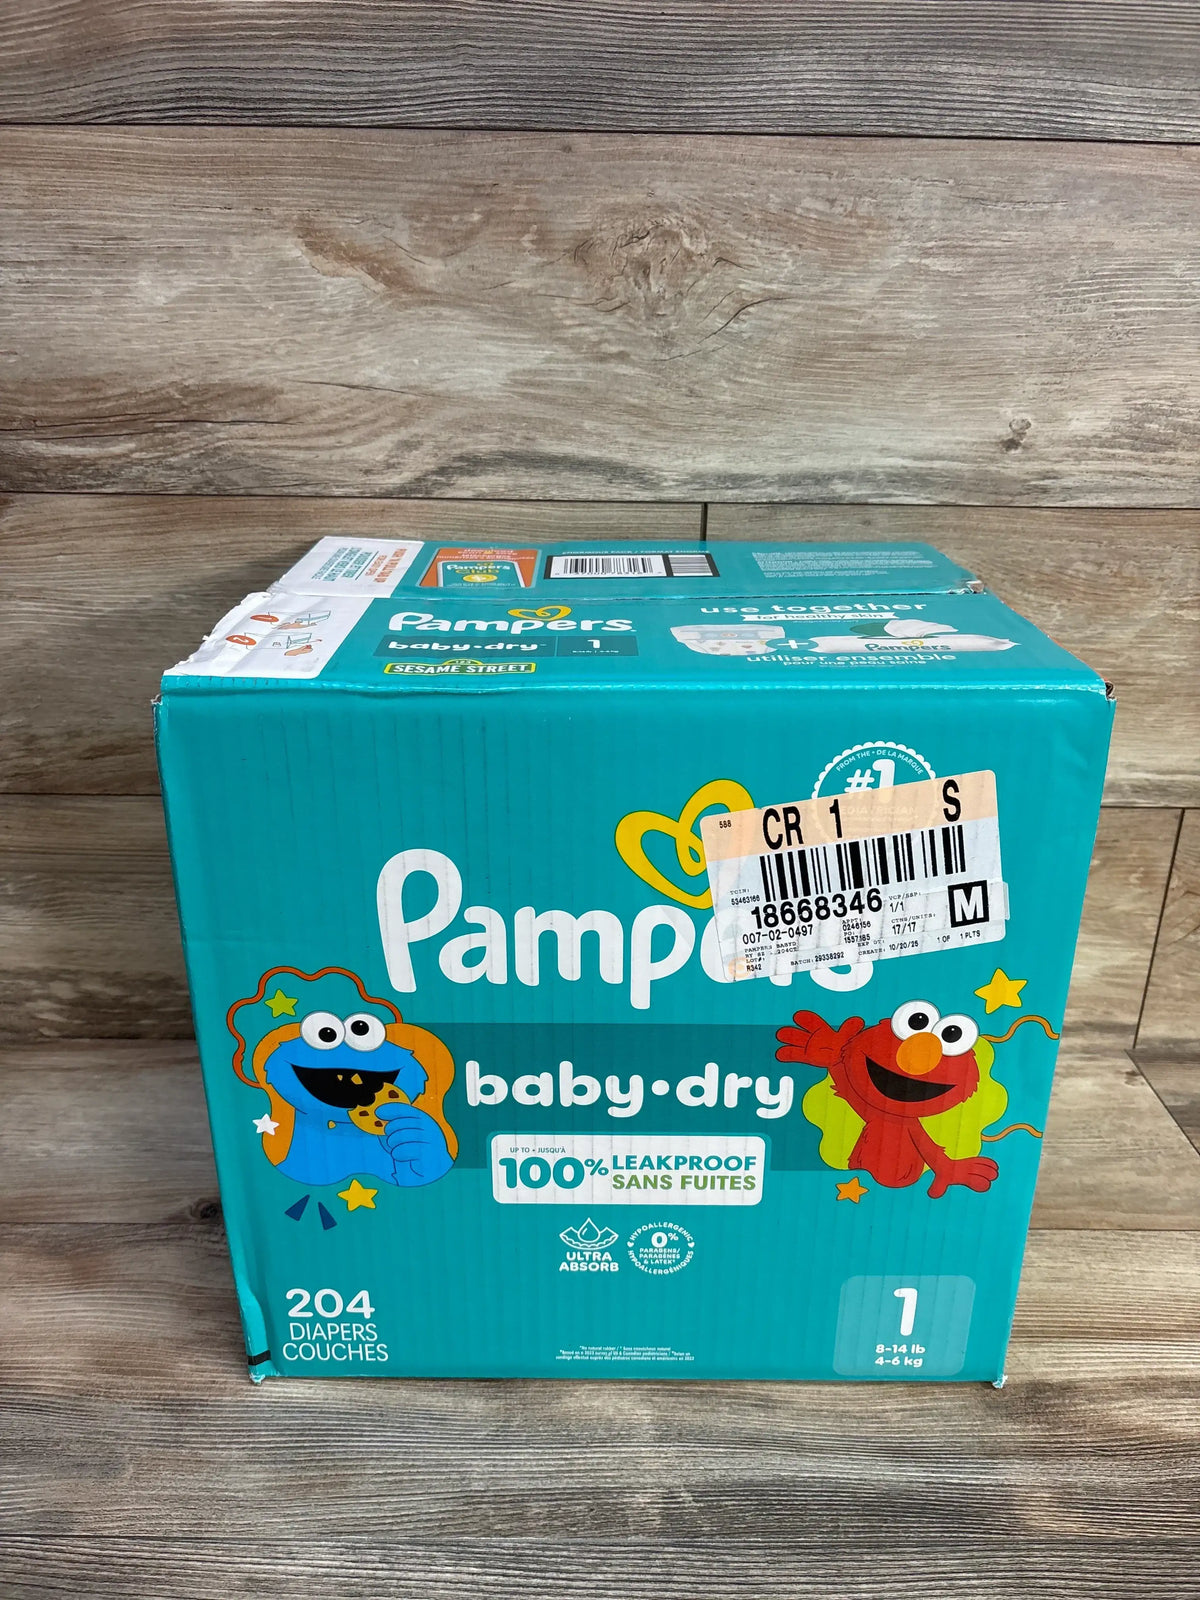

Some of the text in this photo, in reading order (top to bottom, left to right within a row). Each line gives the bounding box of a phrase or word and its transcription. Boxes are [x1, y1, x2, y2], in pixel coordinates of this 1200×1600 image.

[700, 603, 928, 615] use together
[388, 611, 636, 635] Pampers
[587, 639, 601, 649] 1
[864, 643, 952, 652] Pampers
[747, 653, 957, 662] utiliser ensemble
[393, 664, 530, 674] SESAME STREET
[836, 749, 924, 775] FROM THE DE LA MARQUE
[762, 805, 805, 851] CR
[829, 798, 843, 839] 1
[942, 779, 962, 822] S
[719, 820, 732, 829] 588
[751, 887, 884, 930] 18668346
[889, 901, 905, 913] 1/1
[952, 884, 985, 923] M
[376, 847, 874, 1010] Pamp
[742, 924, 814, 946] 007-02-0497
[892, 921, 917, 936] 17/17
[941, 934, 952, 944] OF
[965, 929, 981, 939] PLTS
[745, 963, 763, 972] R342
[509, 1145, 567, 1155] UP TO JUSQU'À
[612, 1154, 758, 1172] LEAKPROOF
[499, 1156, 610, 1190] 100%
[612, 1174, 757, 1191] SANS FUITES
[630, 1221, 695, 1242] HYPOALLERGENIC
[651, 1231, 679, 1249] 0%
[566, 1251, 613, 1261] ULTRA
[559, 1261, 620, 1272] ABSORB
[285, 1287, 377, 1320] 204
[893, 1287, 919, 1337] 1
[289, 1322, 378, 1342] DIAPERS
[282, 1342, 389, 1362] COUCHES
[875, 1343, 926, 1356] 8-14 lb
[874, 1356, 924, 1368] 4-6 kg
